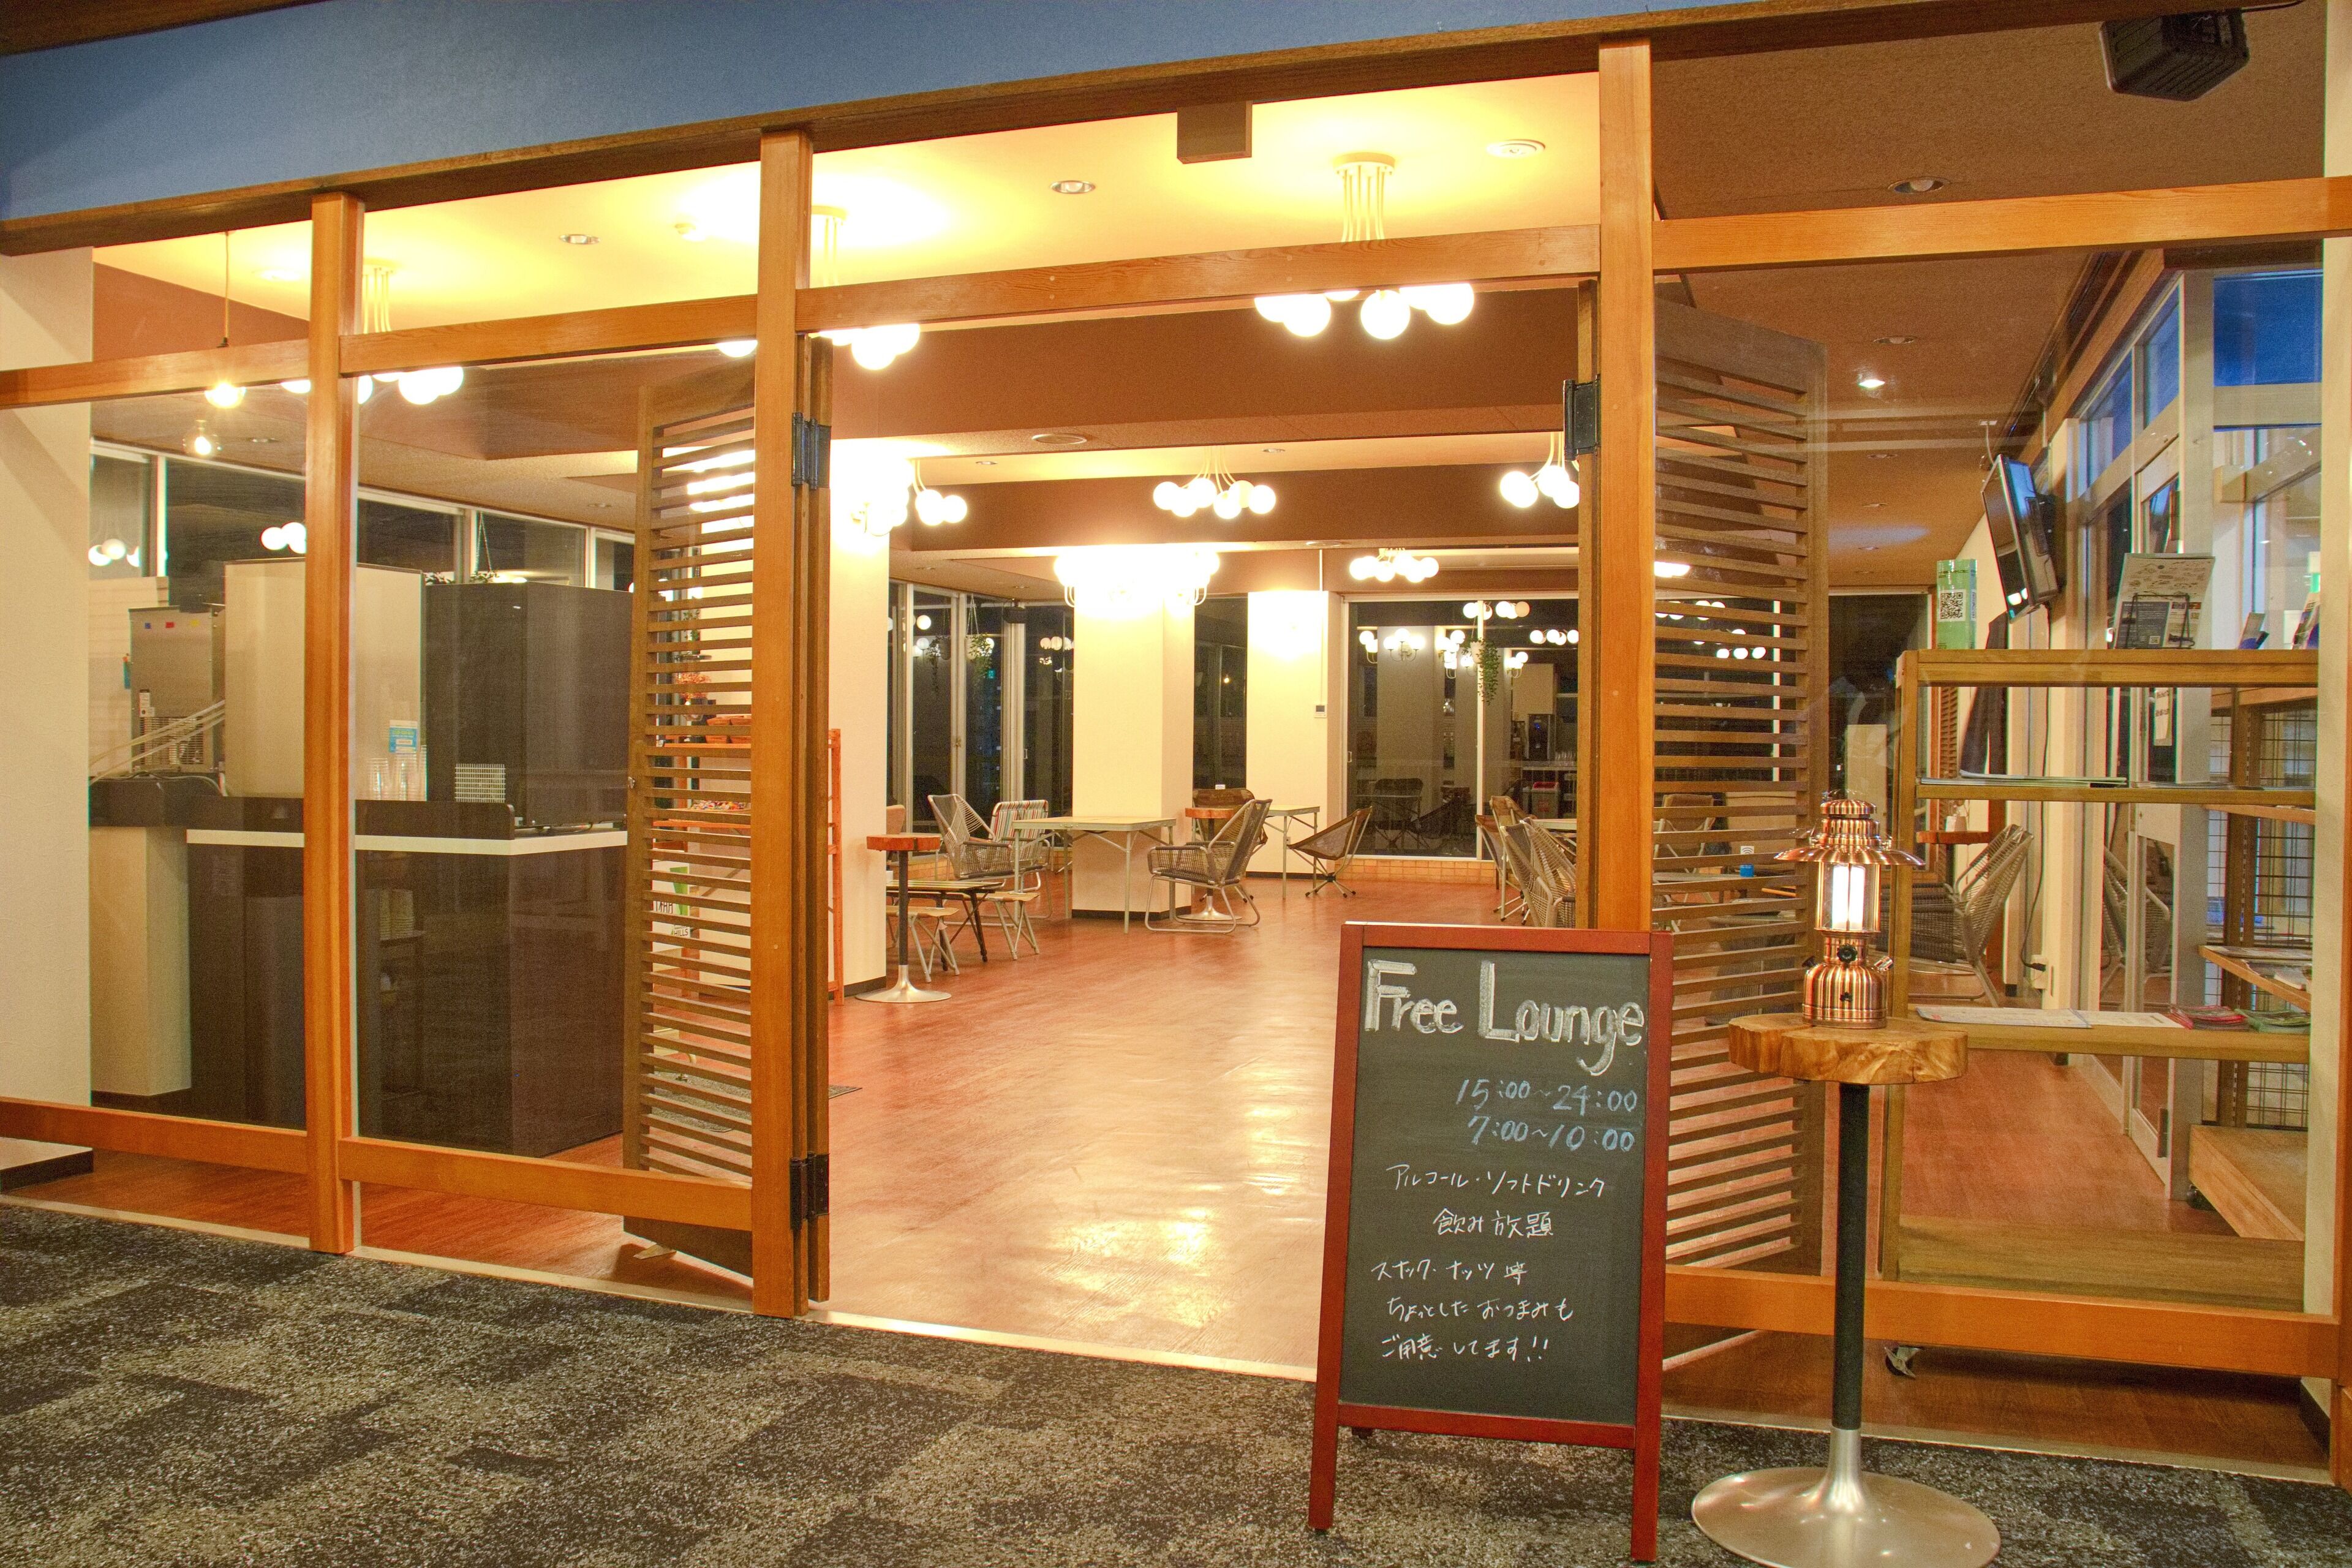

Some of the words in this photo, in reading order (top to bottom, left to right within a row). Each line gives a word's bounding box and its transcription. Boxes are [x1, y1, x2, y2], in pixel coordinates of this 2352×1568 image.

[1364, 959, 1464, 1033] Free
[1477, 959, 1645, 1076] Lounge
[1432, 1207, 1554, 1239] 飲み放題
